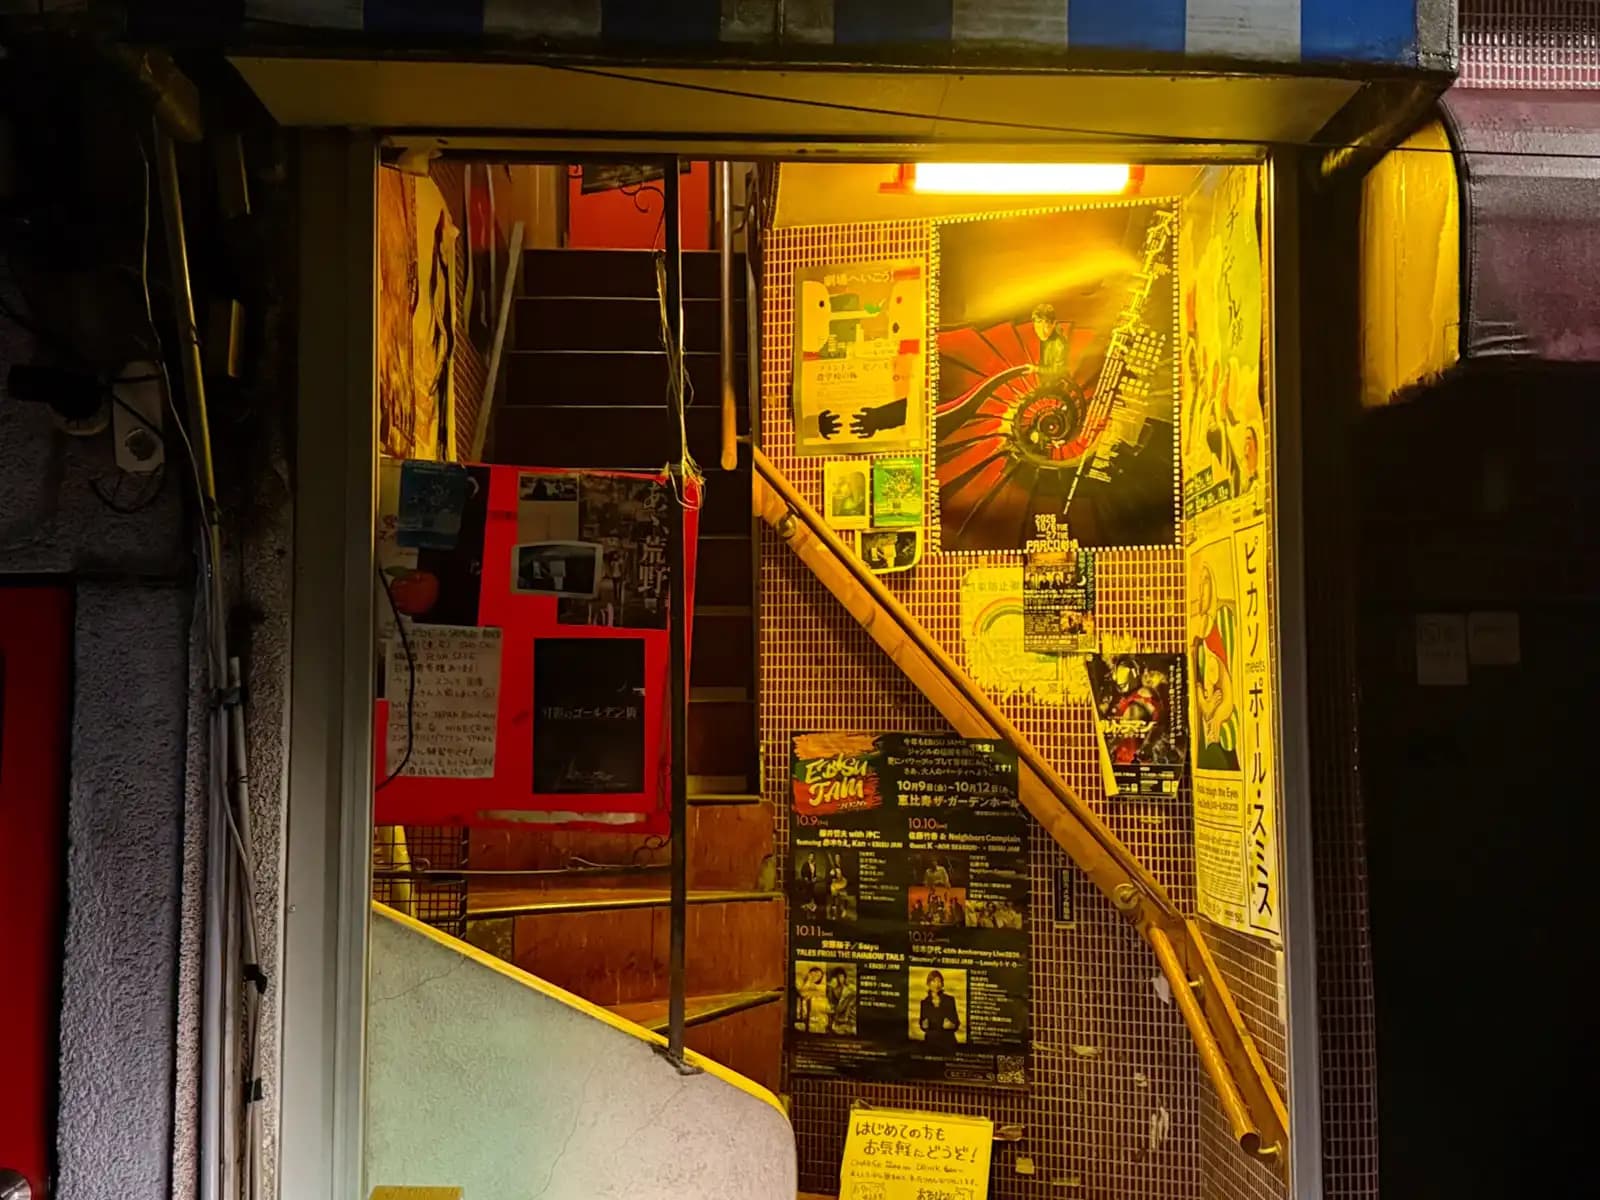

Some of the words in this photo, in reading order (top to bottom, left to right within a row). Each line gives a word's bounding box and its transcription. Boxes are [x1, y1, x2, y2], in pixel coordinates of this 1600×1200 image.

[1243, 535, 1260, 656] ピカソ
[1248, 677, 1274, 919] ポール・スミス
[817, 949, 837, 958] FROM
[838, 950, 851, 959] THE
[856, 1121, 945, 1141] はじめての方も
[863, 1139, 978, 1164] お気軽にどうぞ!
